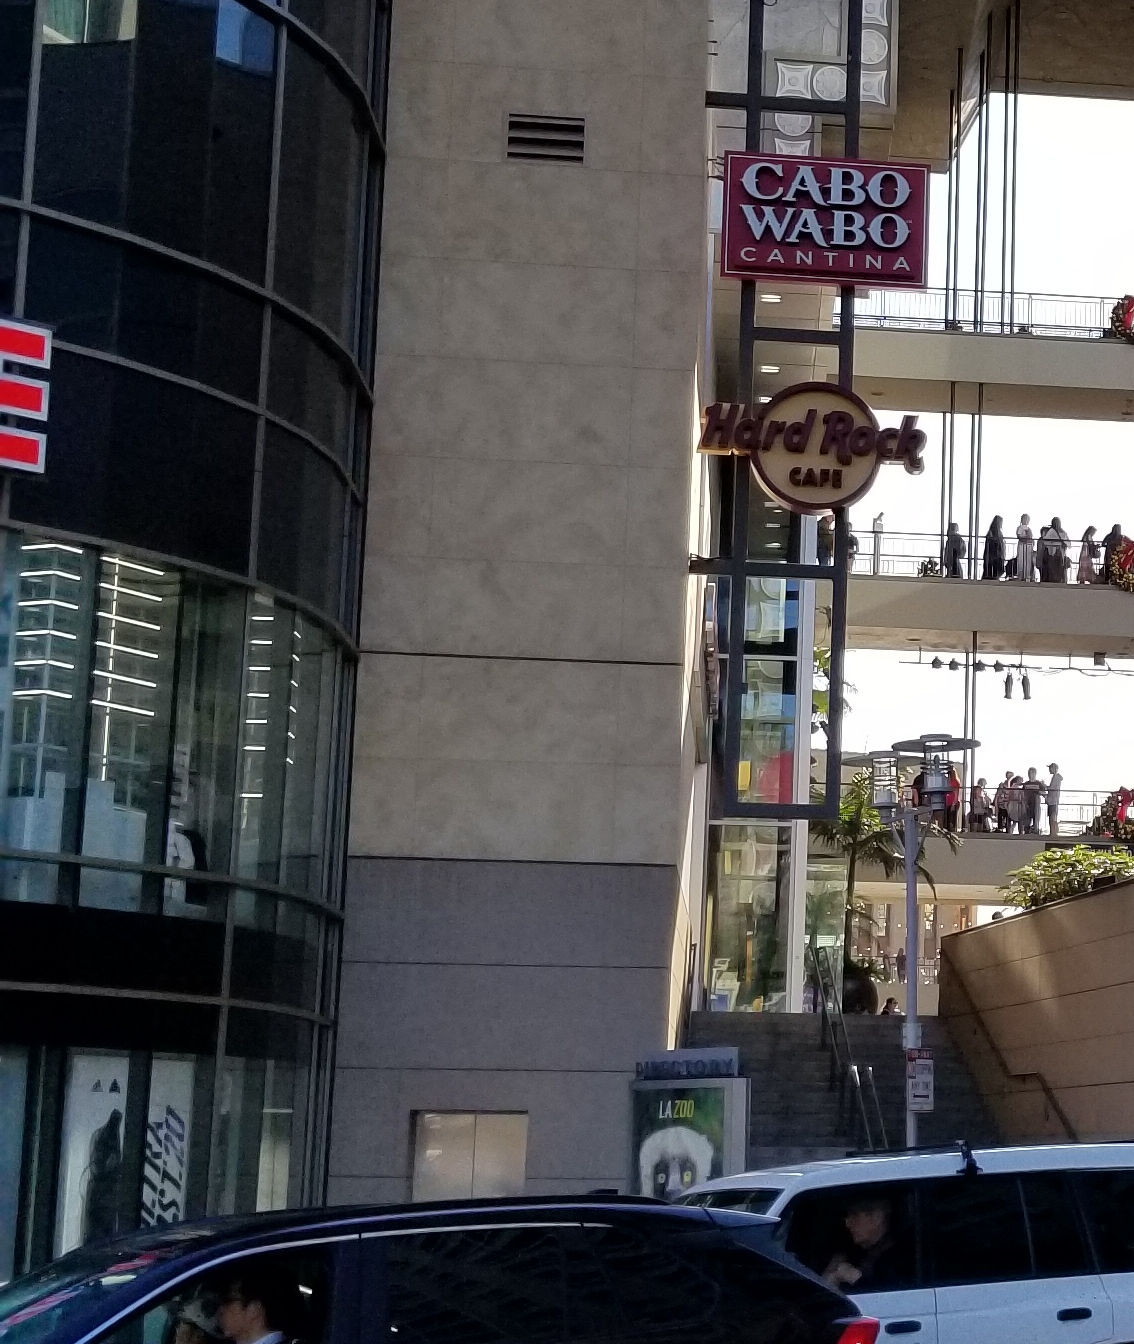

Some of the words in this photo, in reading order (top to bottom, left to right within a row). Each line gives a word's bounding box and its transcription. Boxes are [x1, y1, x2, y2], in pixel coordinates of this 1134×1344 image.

[740, 162, 912, 208] CABO
[740, 204, 912, 248] WABO
[740, 247, 911, 271] CANTINA
[700, 402, 818, 455] Hard
[819, 410, 928, 475] Rock
[788, 466, 843, 489] CAFE
[659, 1100, 672, 1119] LA
[673, 1099, 695, 1119] ZOO
